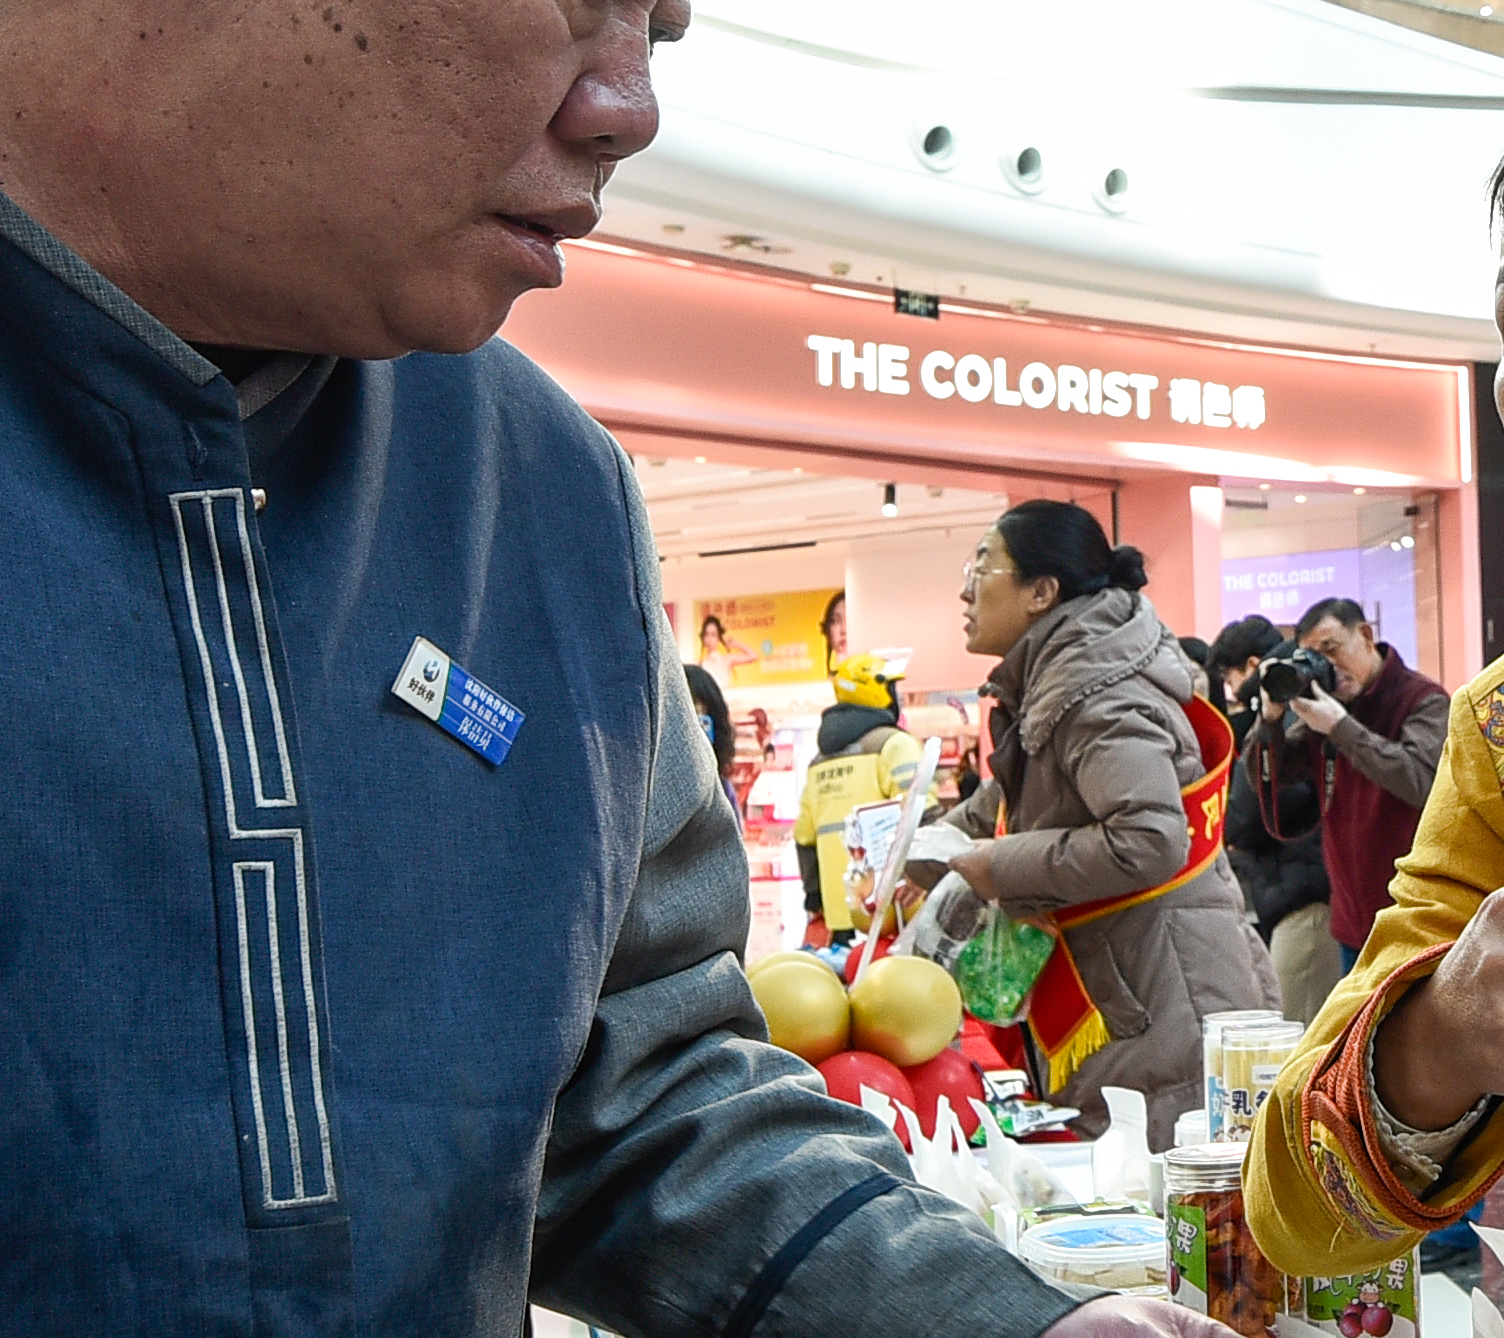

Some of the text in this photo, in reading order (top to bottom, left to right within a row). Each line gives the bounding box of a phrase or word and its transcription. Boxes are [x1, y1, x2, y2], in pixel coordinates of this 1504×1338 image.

[807, 334, 910, 395] THE
[920, 350, 1159, 420] COLORIST
[1223, 566, 1334, 591] THE COLORIST
[406, 676, 436, 704] 好伙伴
